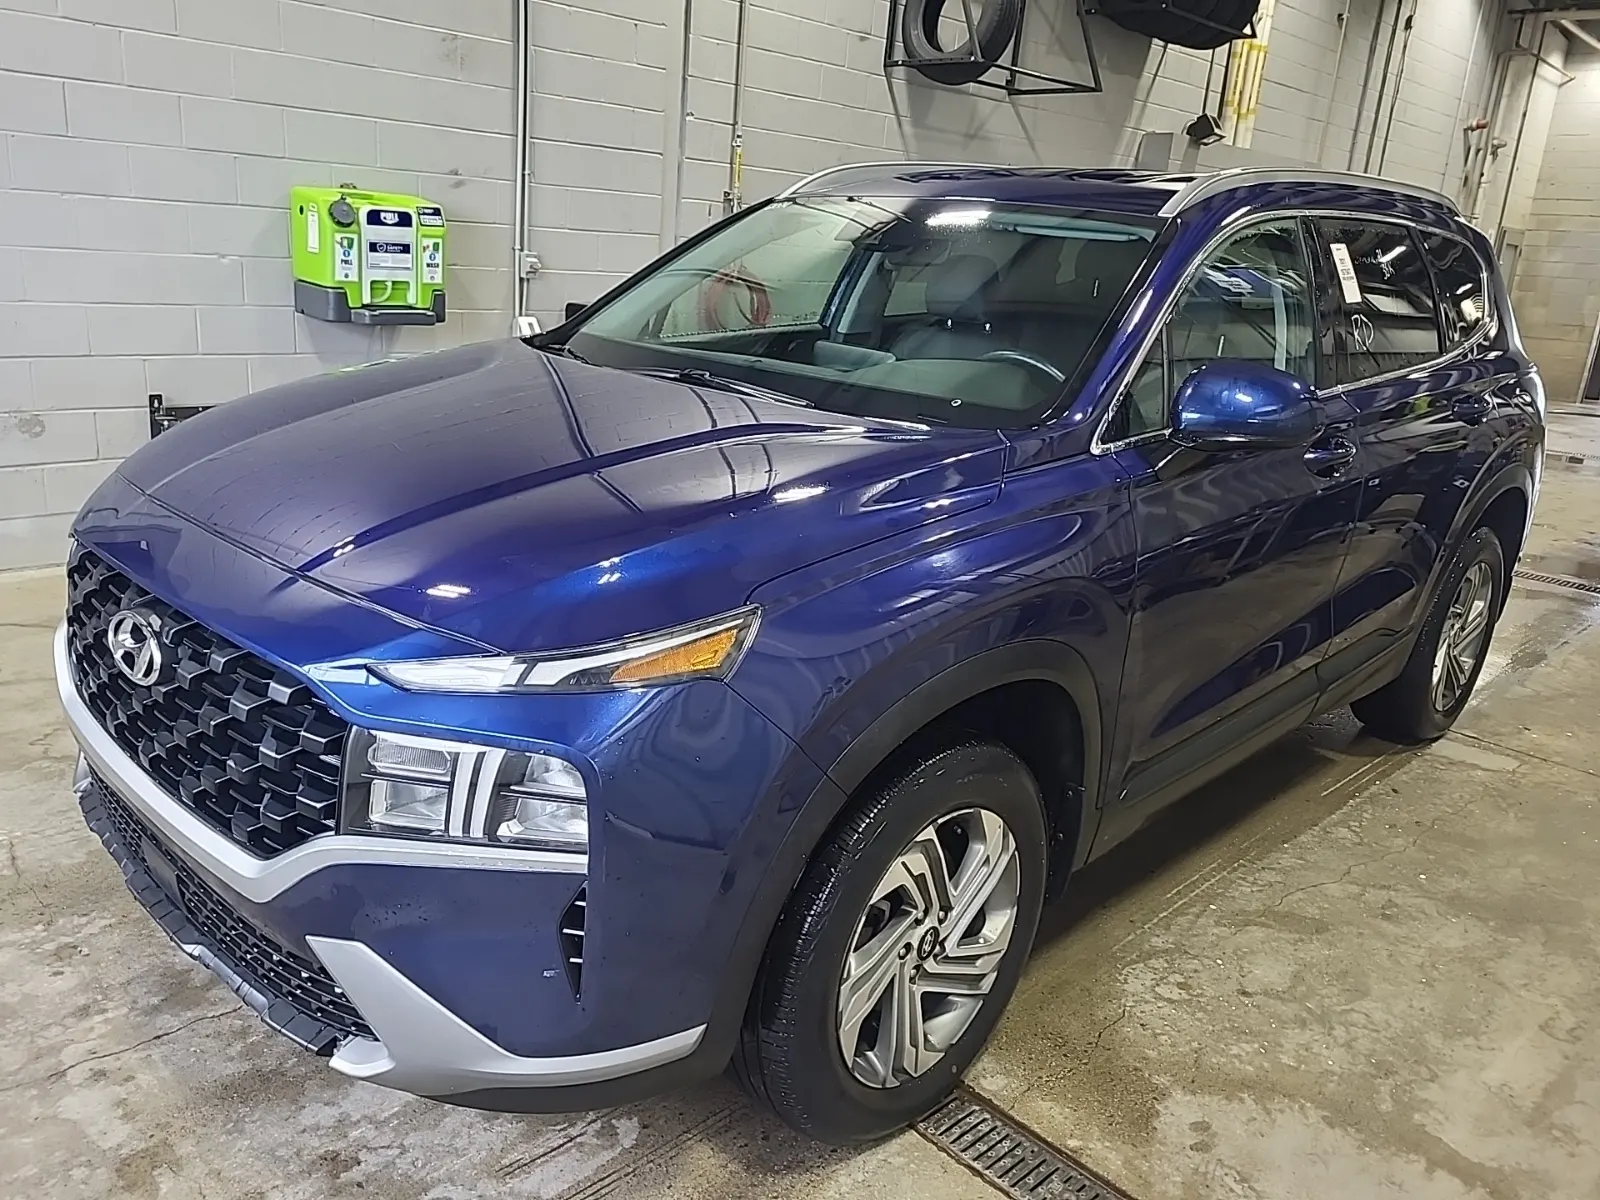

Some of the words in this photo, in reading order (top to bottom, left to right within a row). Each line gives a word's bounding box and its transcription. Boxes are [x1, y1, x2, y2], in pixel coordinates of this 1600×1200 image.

[380, 212, 400, 222] PULL
[340, 258, 353, 266] PULL
[1352, 314, 1374, 351] RD
